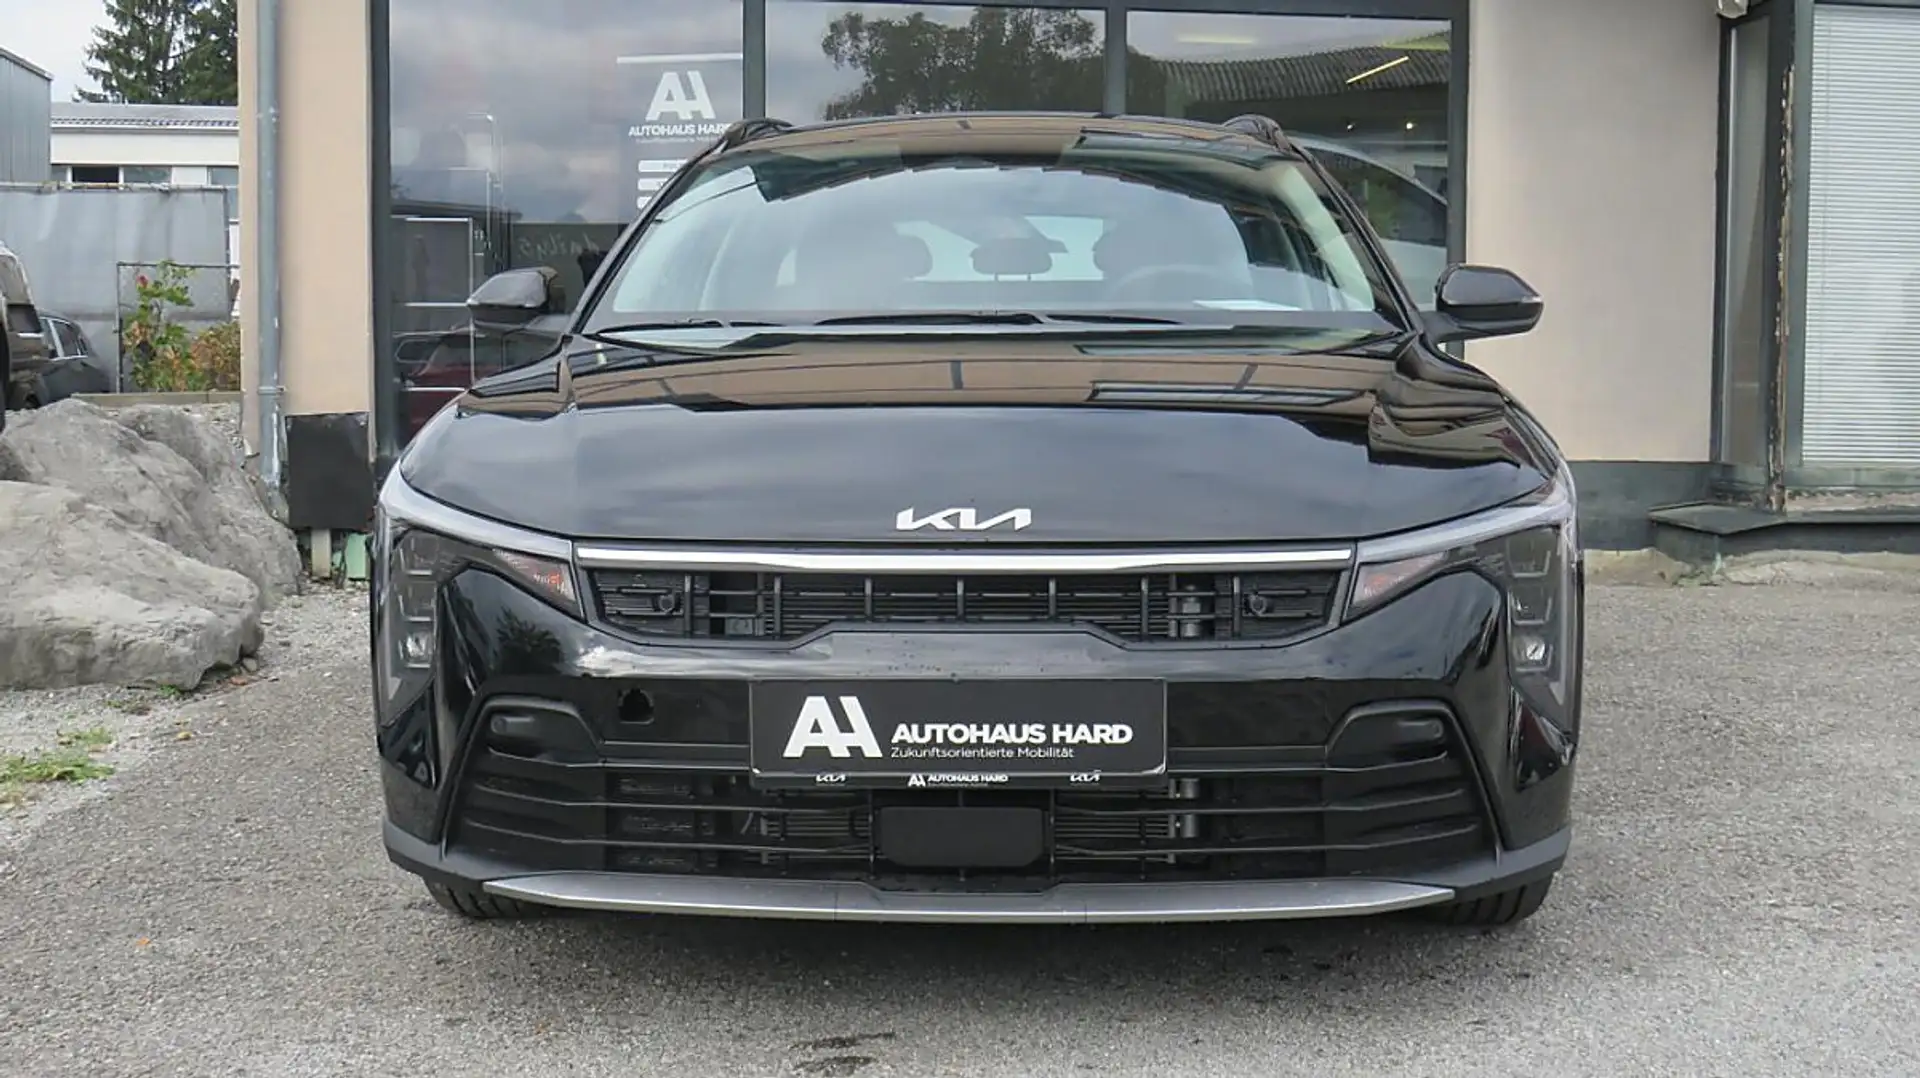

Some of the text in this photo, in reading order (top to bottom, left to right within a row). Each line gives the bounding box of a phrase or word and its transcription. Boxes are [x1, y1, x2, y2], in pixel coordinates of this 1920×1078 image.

[628, 124, 696, 136] AUTOHAUS
[896, 507, 1032, 531] KIA
[891, 723, 1134, 744] AUTOHAUS HARD
[891, 746, 1075, 759] Zukunftsorientierte Mobilität
[928, 774, 979, 783] AUTOHAUS
